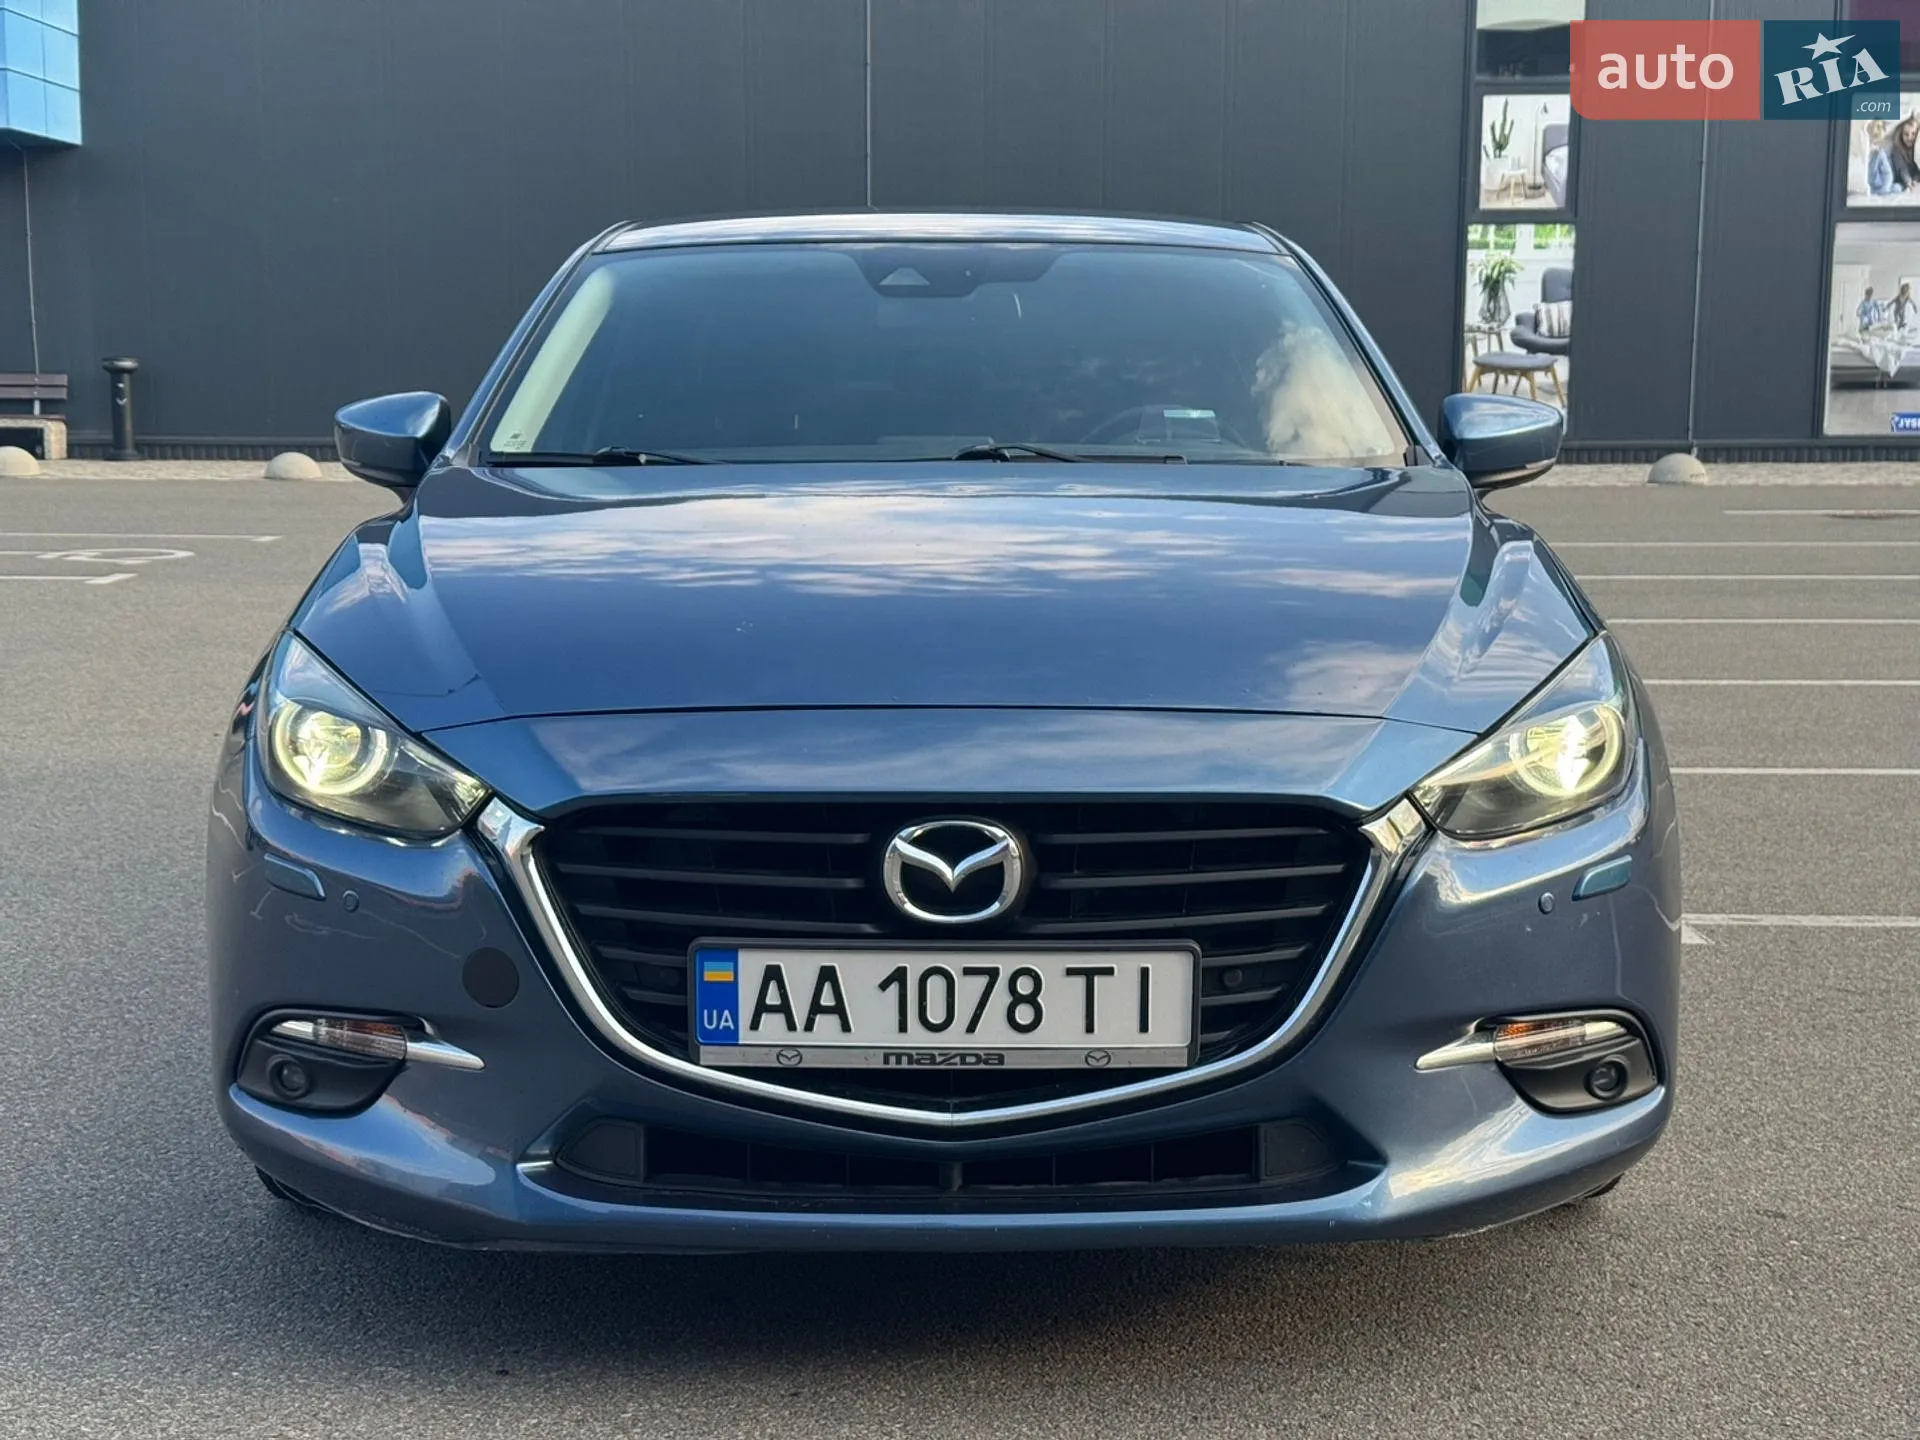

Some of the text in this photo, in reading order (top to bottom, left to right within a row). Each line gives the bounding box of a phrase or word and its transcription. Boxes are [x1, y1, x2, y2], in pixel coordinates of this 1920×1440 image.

[703, 1009, 735, 1030] UA
[749, 963, 1151, 1034] AA 1078 TI
